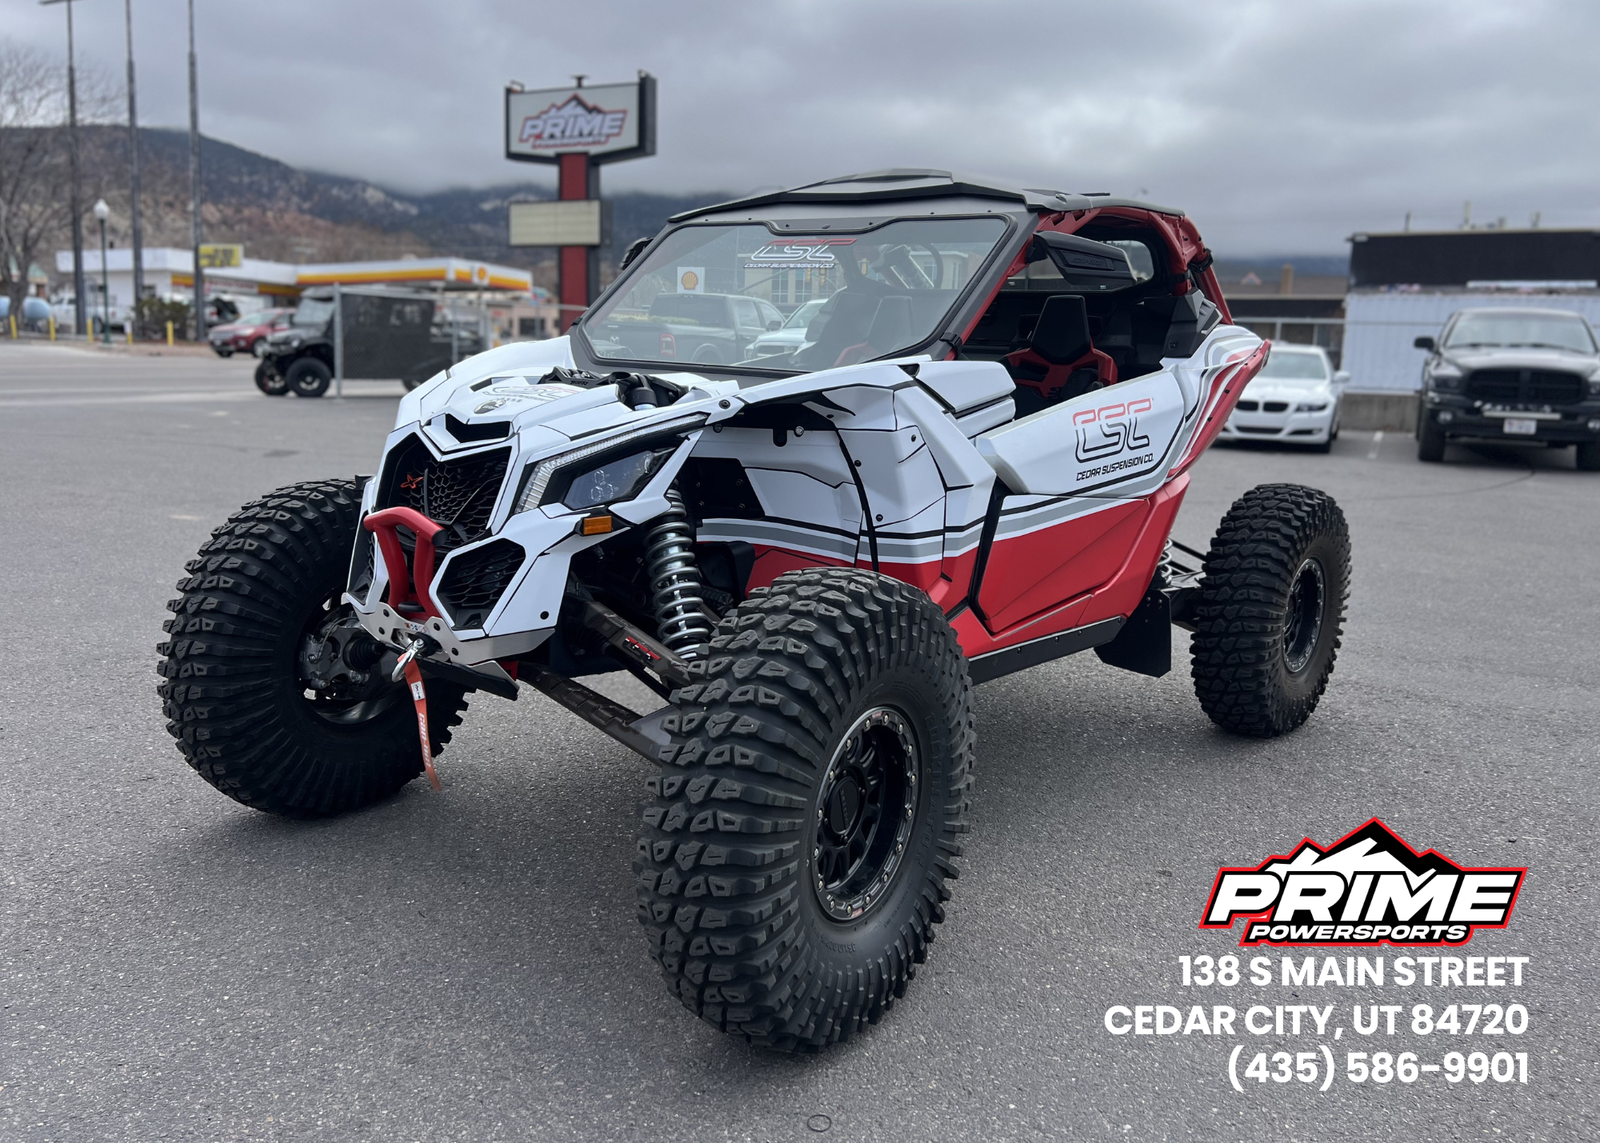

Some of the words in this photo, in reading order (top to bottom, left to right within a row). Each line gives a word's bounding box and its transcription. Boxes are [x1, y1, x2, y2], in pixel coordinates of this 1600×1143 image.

[520, 112, 625, 139] PRIME
[1076, 467, 1101, 481] CEDAR
[1101, 455, 1144, 475] SUSPENSION
